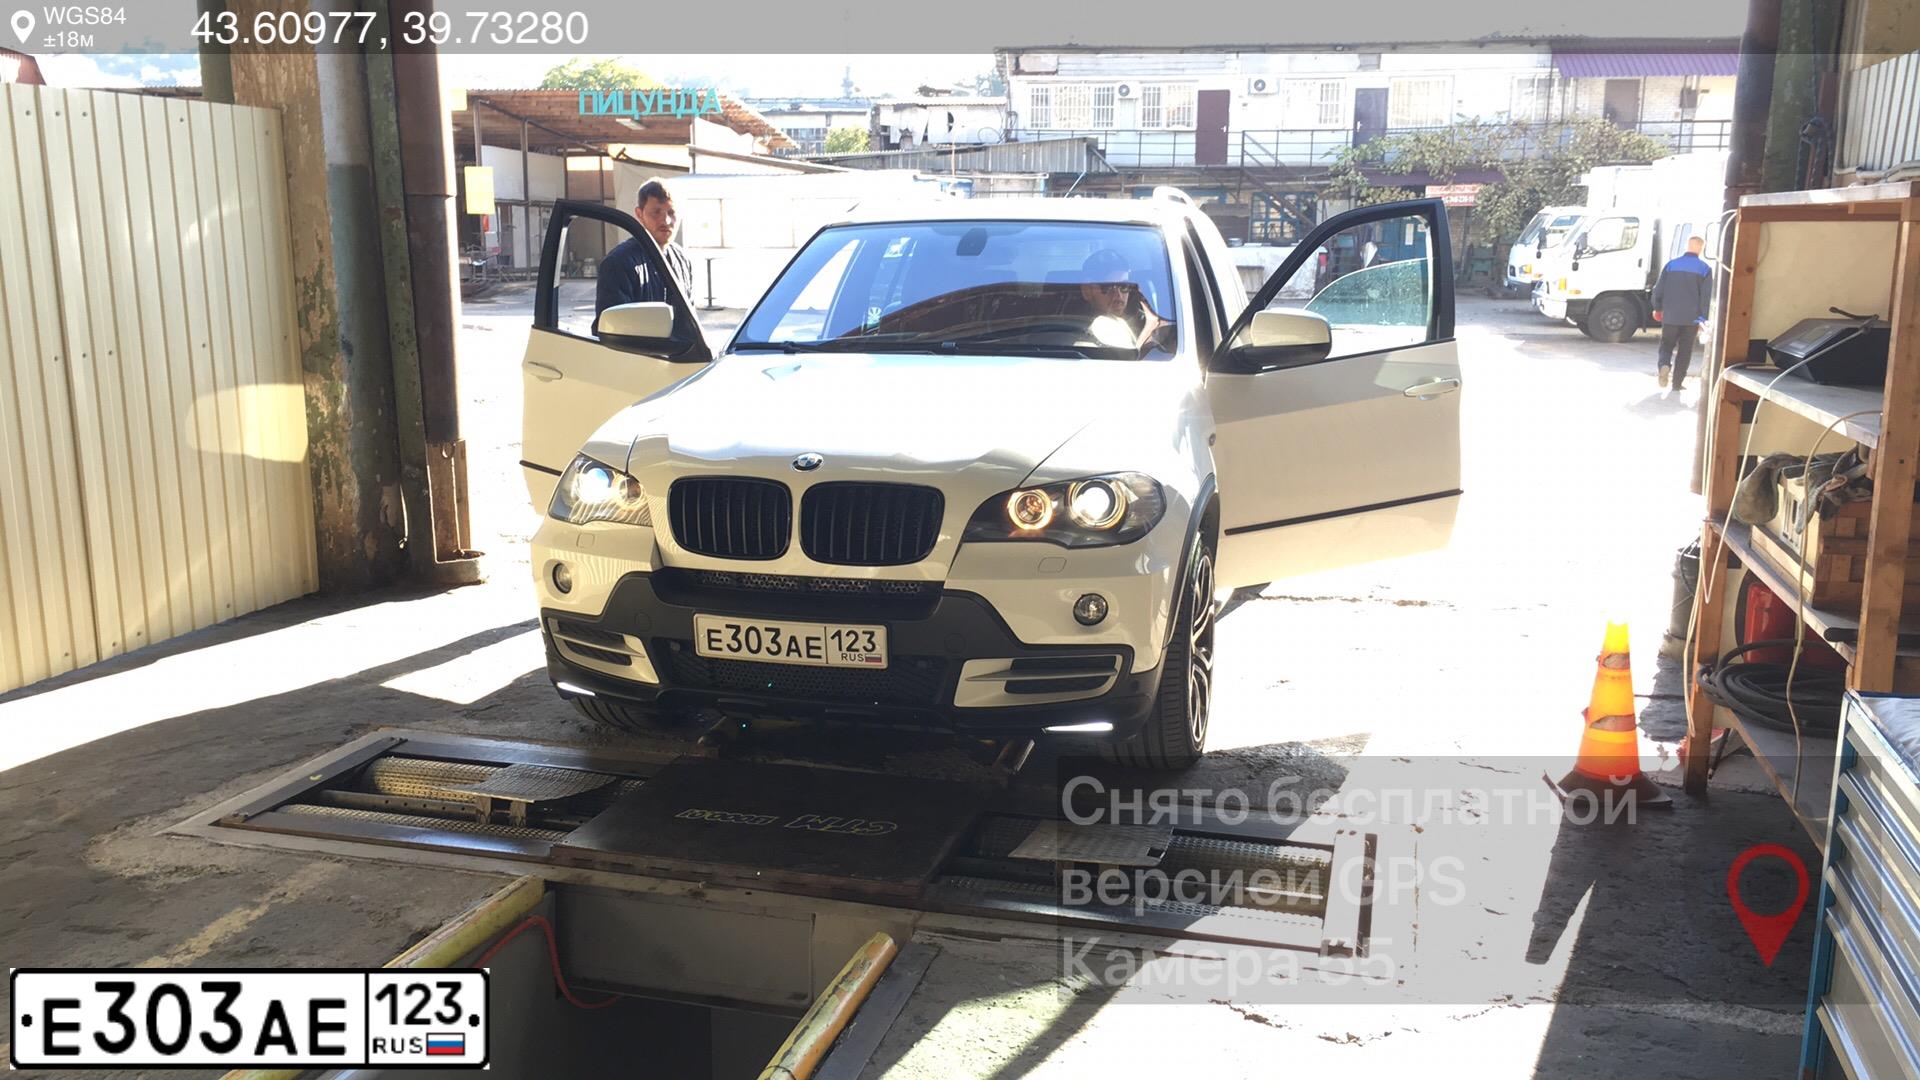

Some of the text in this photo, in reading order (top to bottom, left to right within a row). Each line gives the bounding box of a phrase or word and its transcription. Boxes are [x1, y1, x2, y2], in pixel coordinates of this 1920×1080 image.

[578, 88, 724, 120] ПИЦУНДА
[830, 629, 877, 652] 123
[840, 652, 865, 662] RUS
